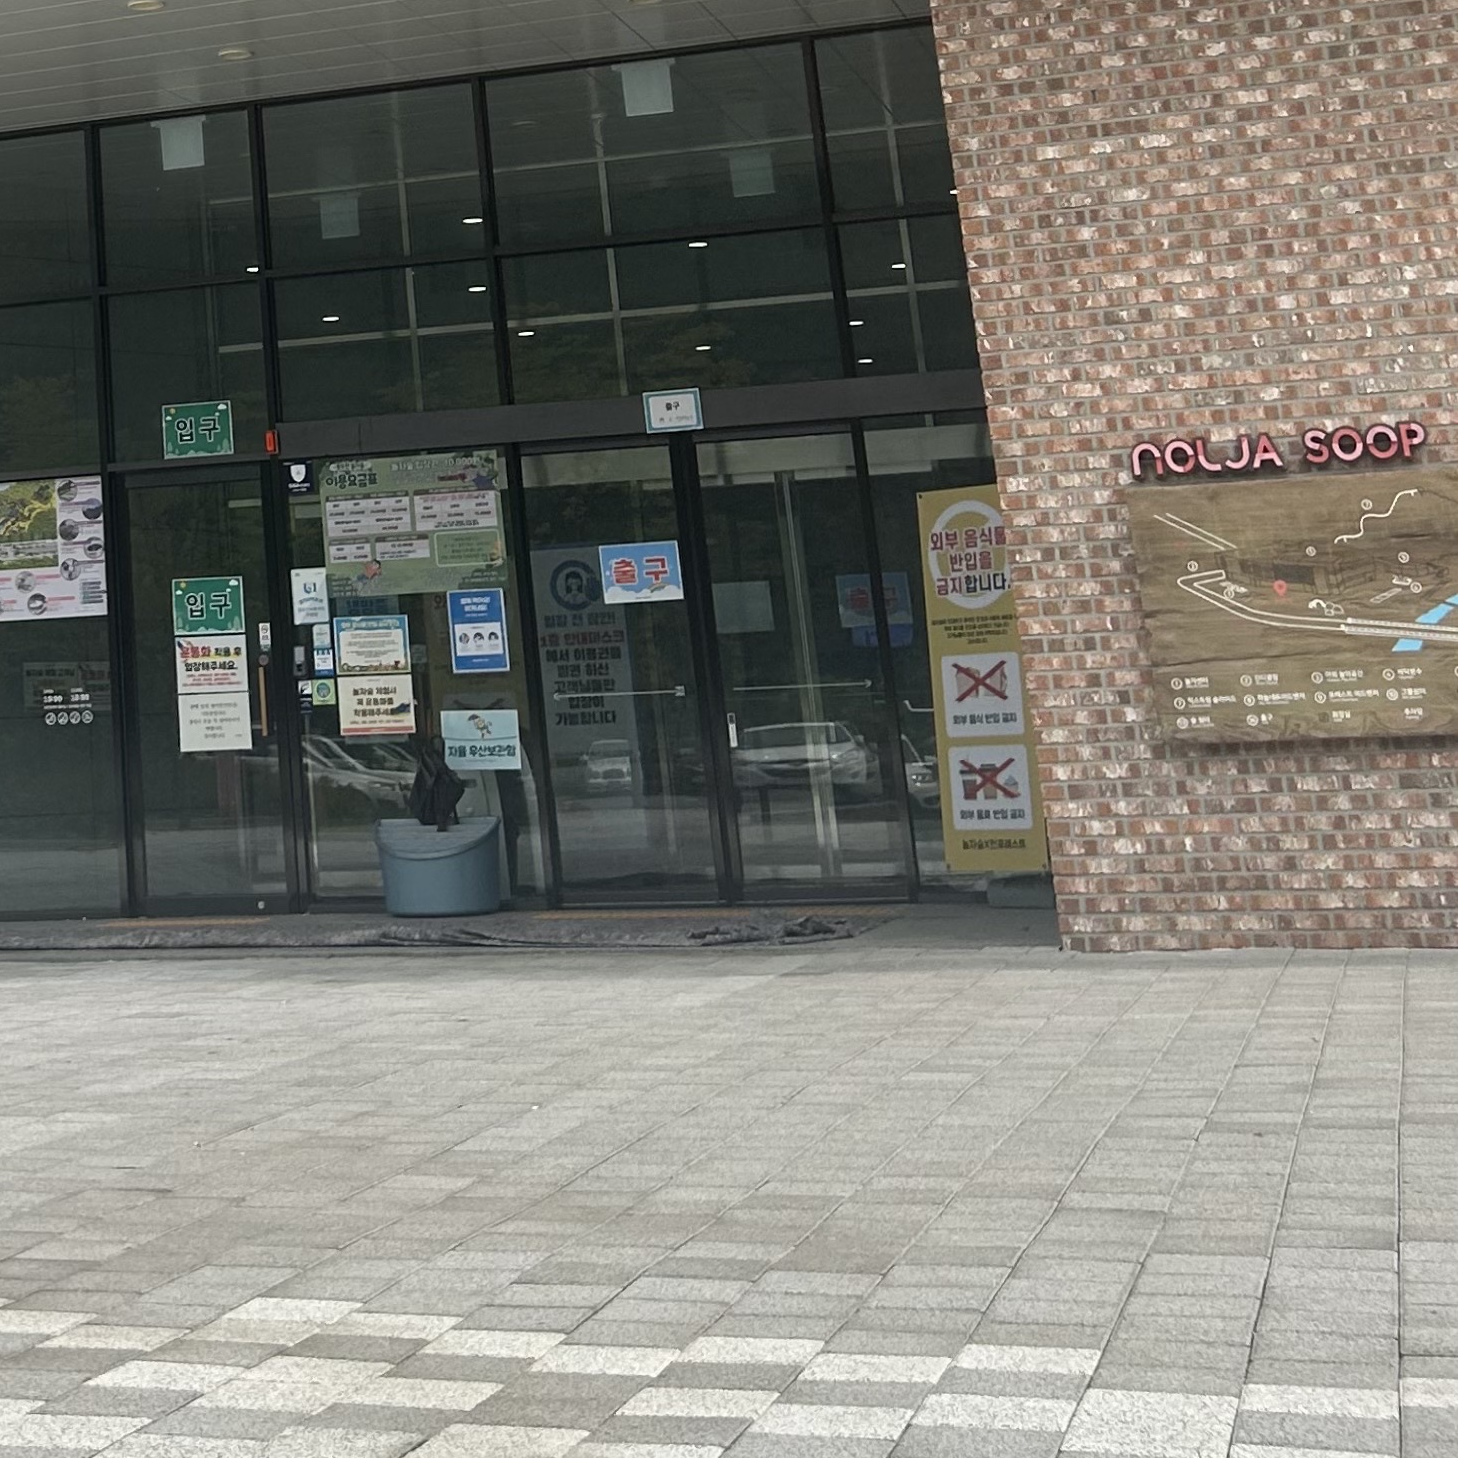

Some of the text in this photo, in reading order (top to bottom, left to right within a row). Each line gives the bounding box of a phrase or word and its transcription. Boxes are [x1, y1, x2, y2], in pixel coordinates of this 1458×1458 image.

[175, 416, 220, 443] 입구
[1130, 420, 1428, 477] NOLJA SOOP
[325, 472, 378, 489] 이용요금표
[930, 526, 1007, 551] 외부 음식물
[612, 556, 669, 585] 출구
[949, 550, 993, 573] 반입을
[936, 573, 1012, 597] 금지합니다.
[185, 591, 232, 621] 입구
